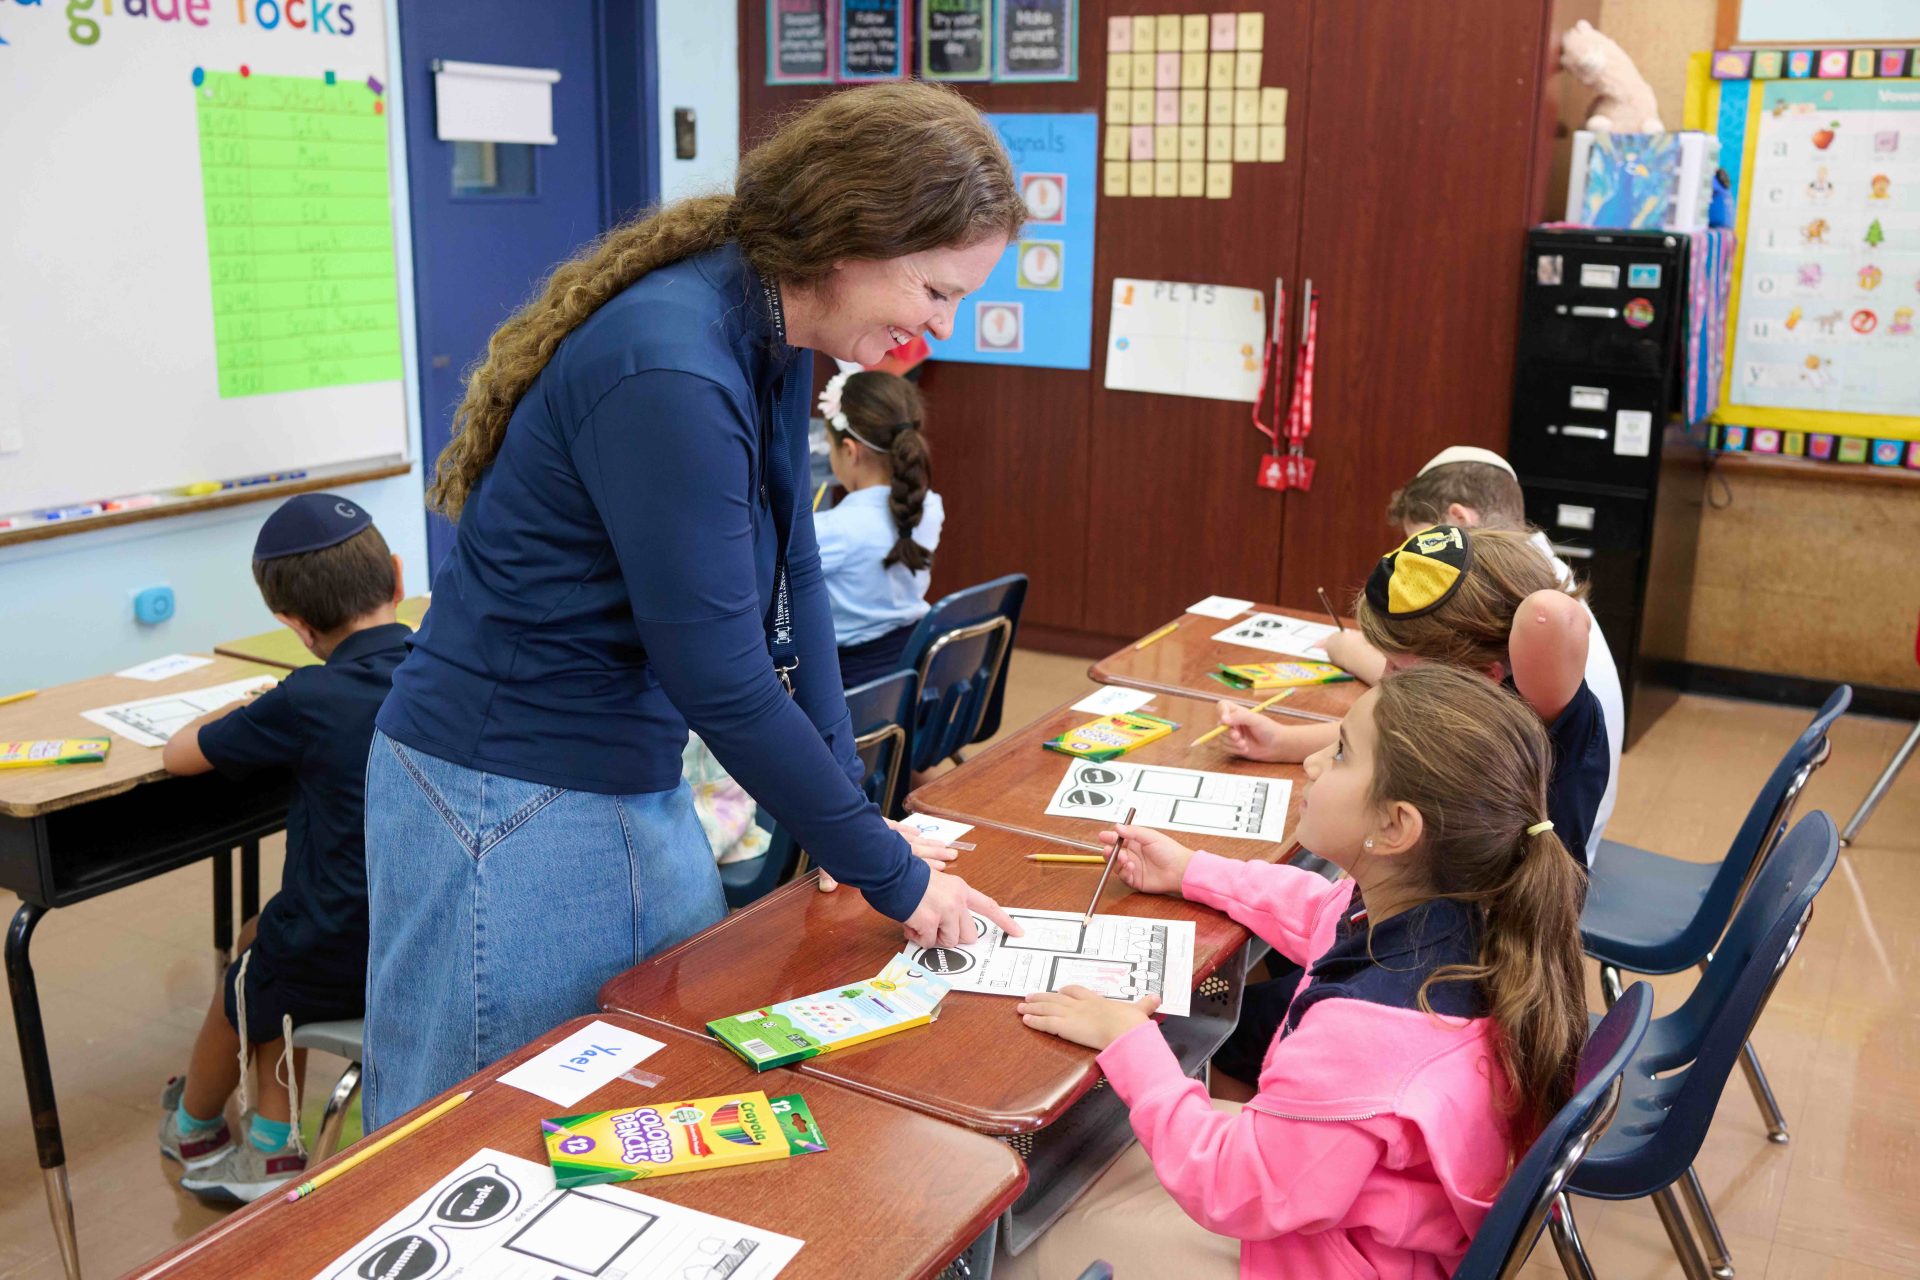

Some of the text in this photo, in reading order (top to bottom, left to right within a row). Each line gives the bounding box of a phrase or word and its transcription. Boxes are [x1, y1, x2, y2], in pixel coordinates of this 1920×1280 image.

[997, 121, 1065, 165] Signals
[1154, 283, 1219, 305] PETS
[773, 308, 781, 328] RABBI
[937, 948, 949, 973] Summer
[559, 1043, 622, 1073] Yael
[740, 1102, 767, 1141] Crayola
[770, 1100, 792, 1114] 12
[566, 1138, 589, 1153] 12
[610, 1112, 651, 1164] PENCILS
[634, 1108, 673, 1163] COLORED
[460, 1184, 495, 1217] Break
